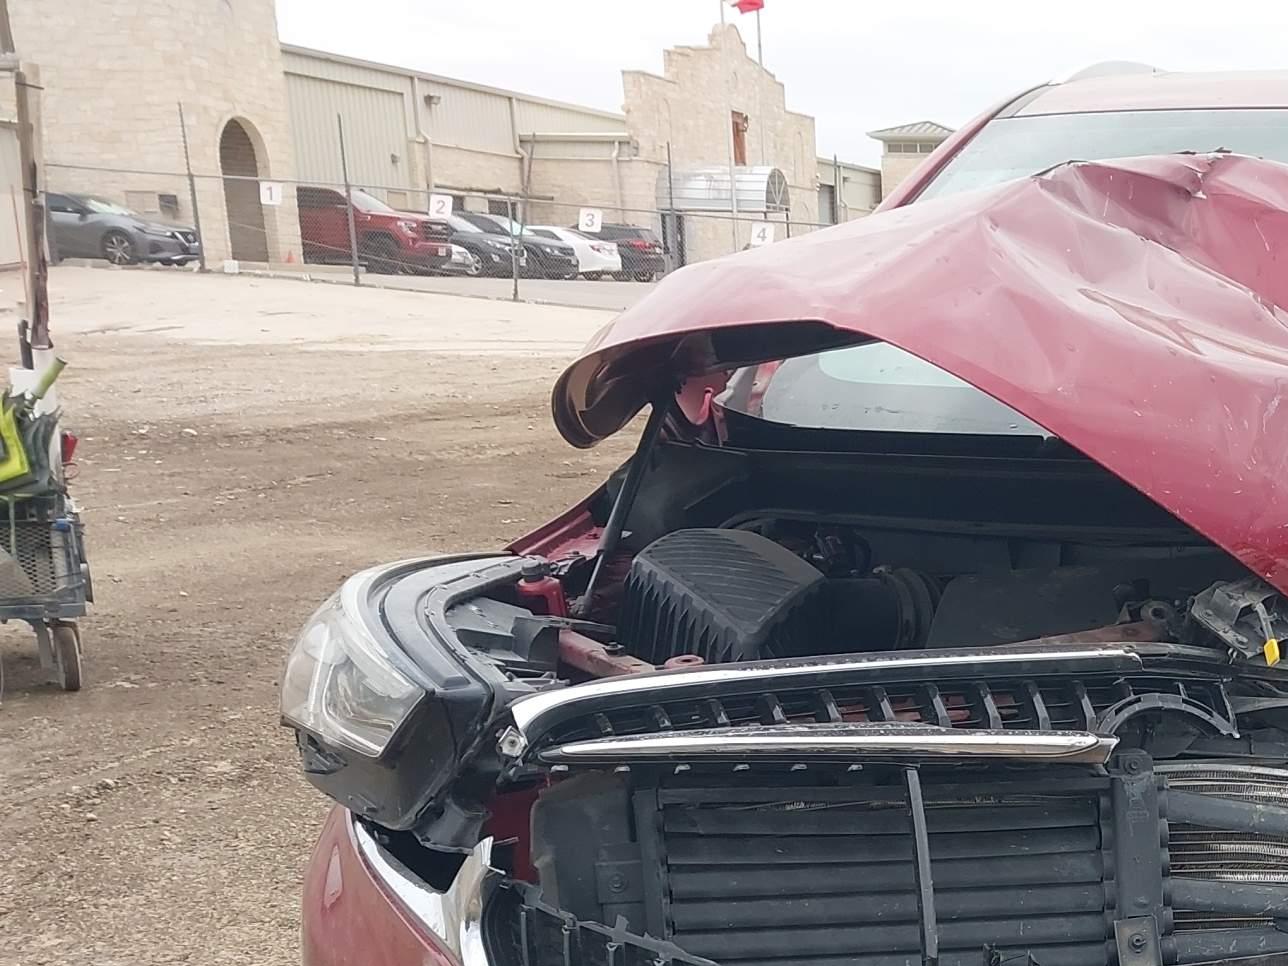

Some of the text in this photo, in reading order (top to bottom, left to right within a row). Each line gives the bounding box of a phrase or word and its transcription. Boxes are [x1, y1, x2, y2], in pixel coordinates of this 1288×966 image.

[266, 186, 274, 200] 1
[435, 200, 446, 214] 2
[585, 213, 595, 227] 3
[756, 227, 767, 242] 4
